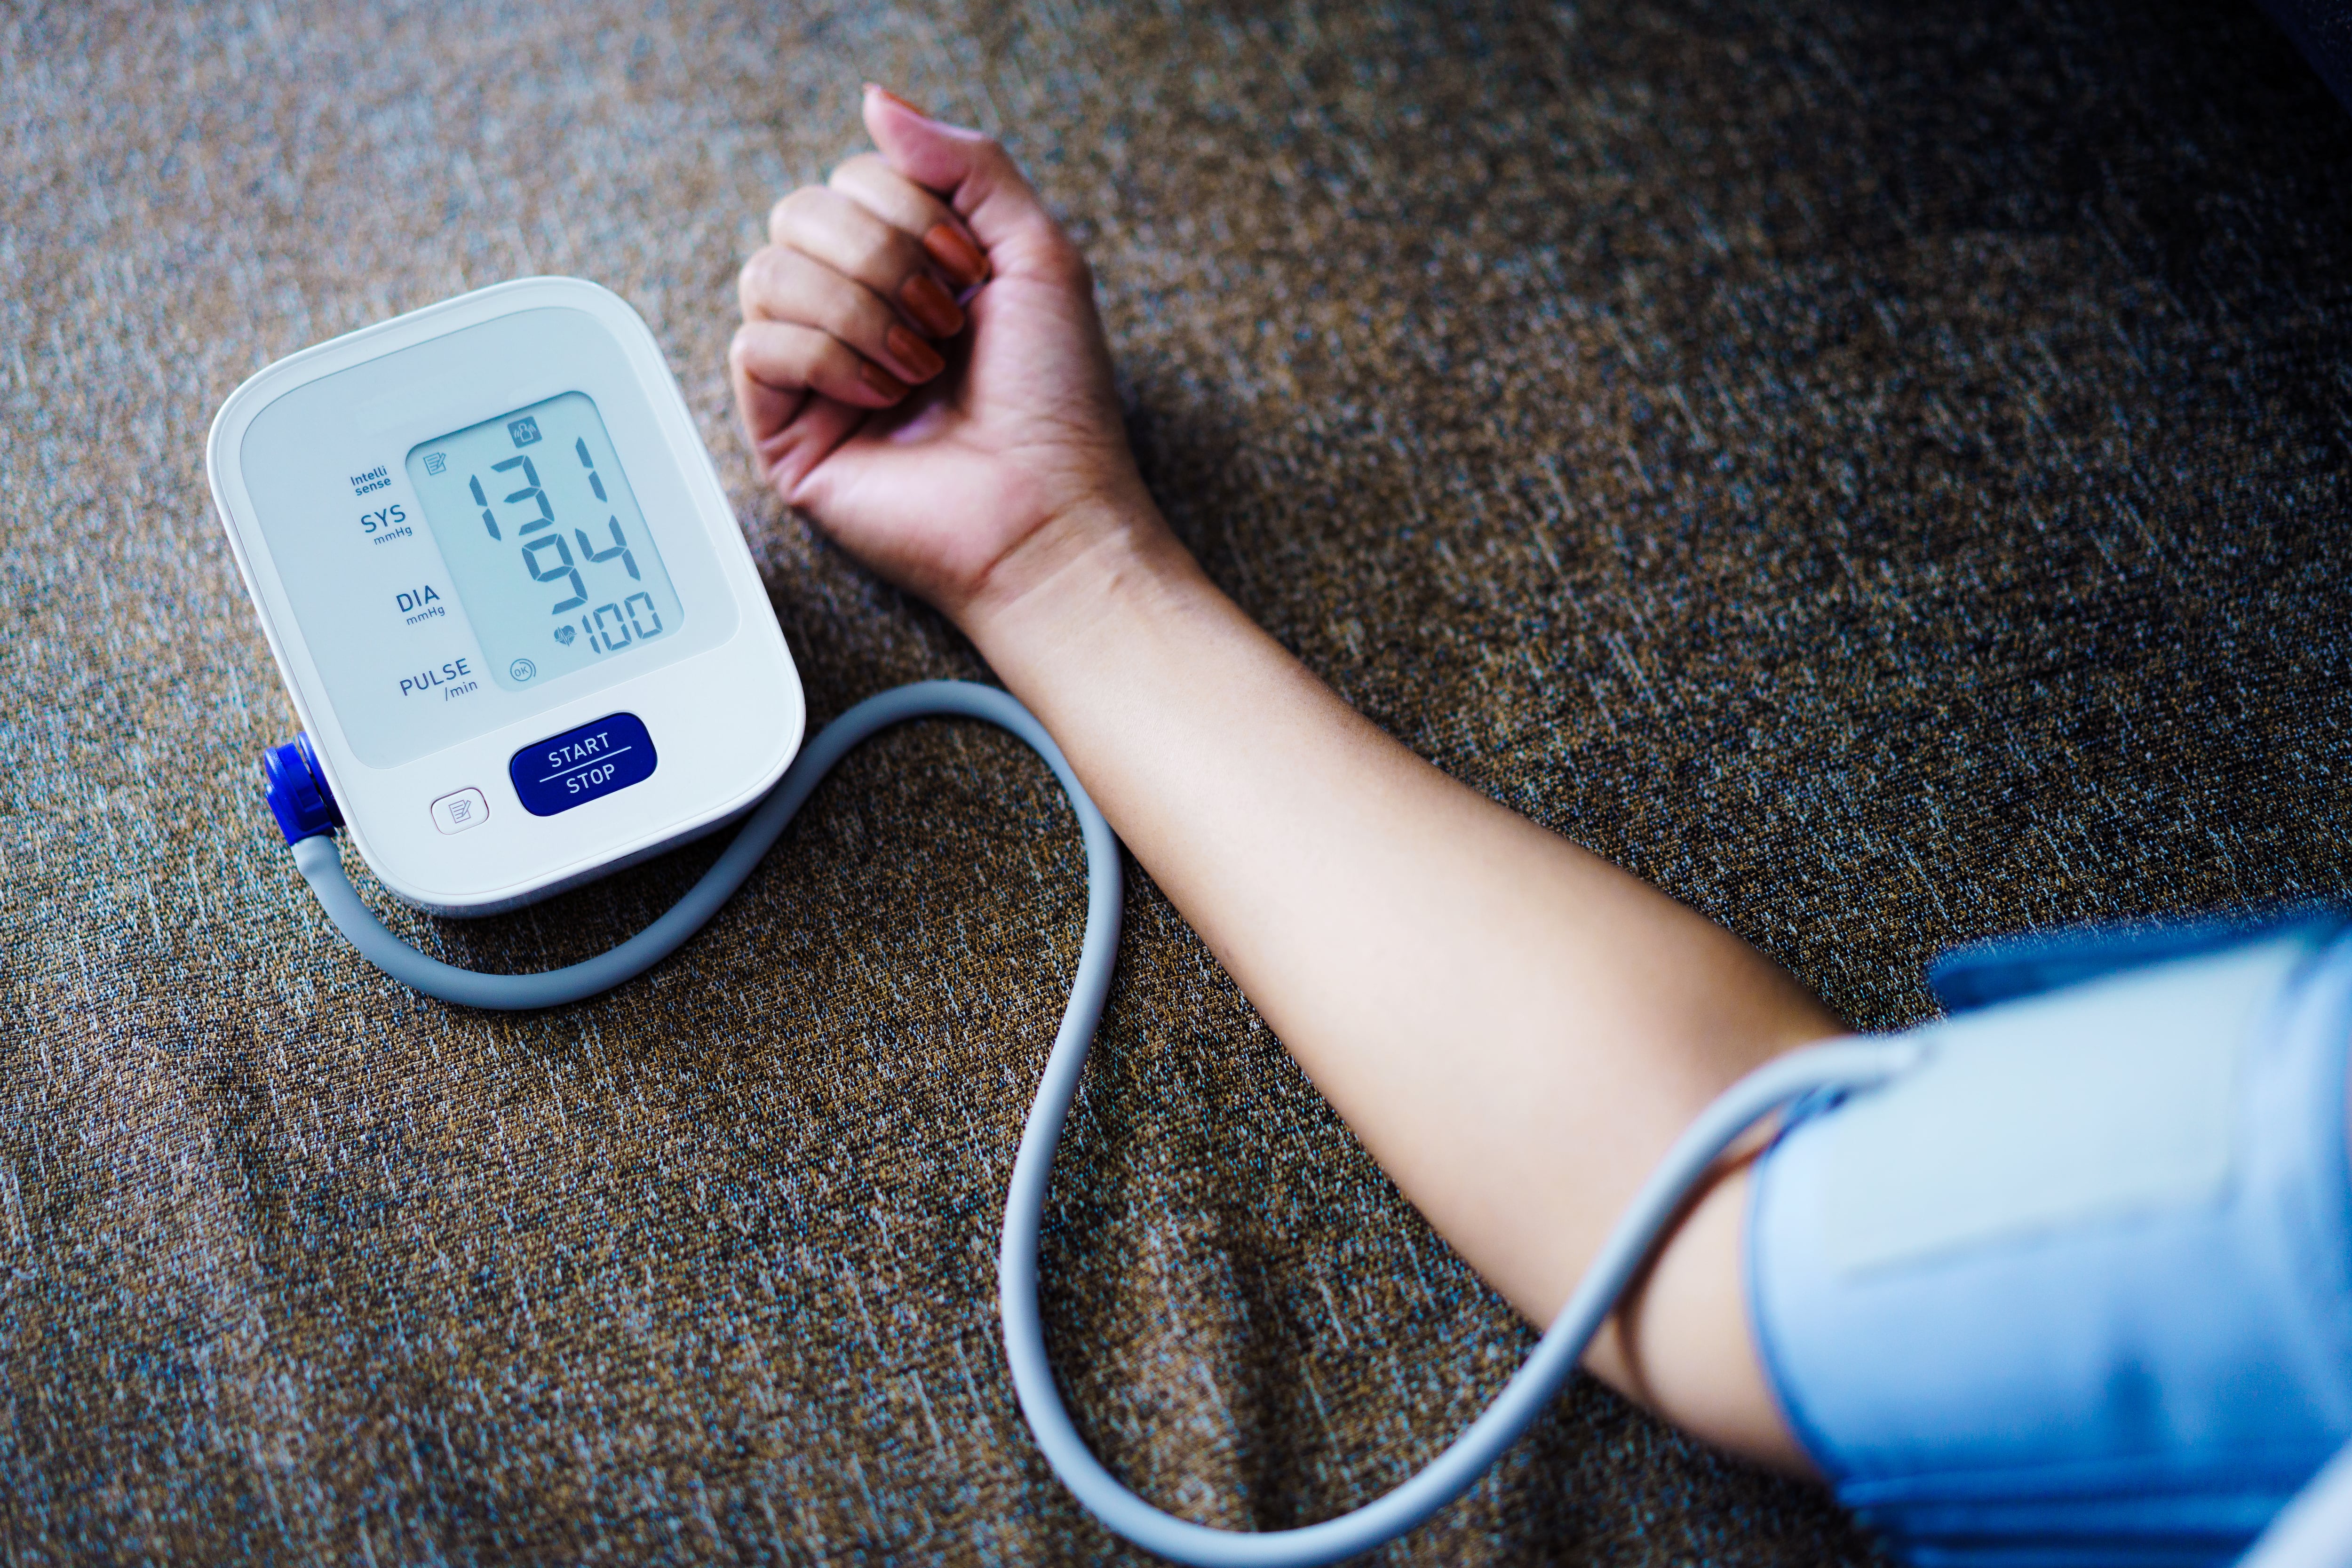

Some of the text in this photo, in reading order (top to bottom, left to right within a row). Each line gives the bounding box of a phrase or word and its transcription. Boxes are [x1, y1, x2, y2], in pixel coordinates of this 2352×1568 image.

[350, 466, 388, 487] Intelli
[355, 477, 391, 496] sense
[469, 436, 608, 541] 131
[360, 504, 406, 534] SYS
[373, 525, 413, 545] mmHg
[521, 515, 641, 615] 94
[396, 584, 440, 613] DIA
[406, 605, 445, 626] mmHg
[581, 591, 664, 654] 100
[399, 658, 471, 697] PULSE
[514, 666, 528, 677] OK
[444, 680, 478, 701] /min
[548, 732, 611, 768] START
[566, 764, 616, 795] STOP
